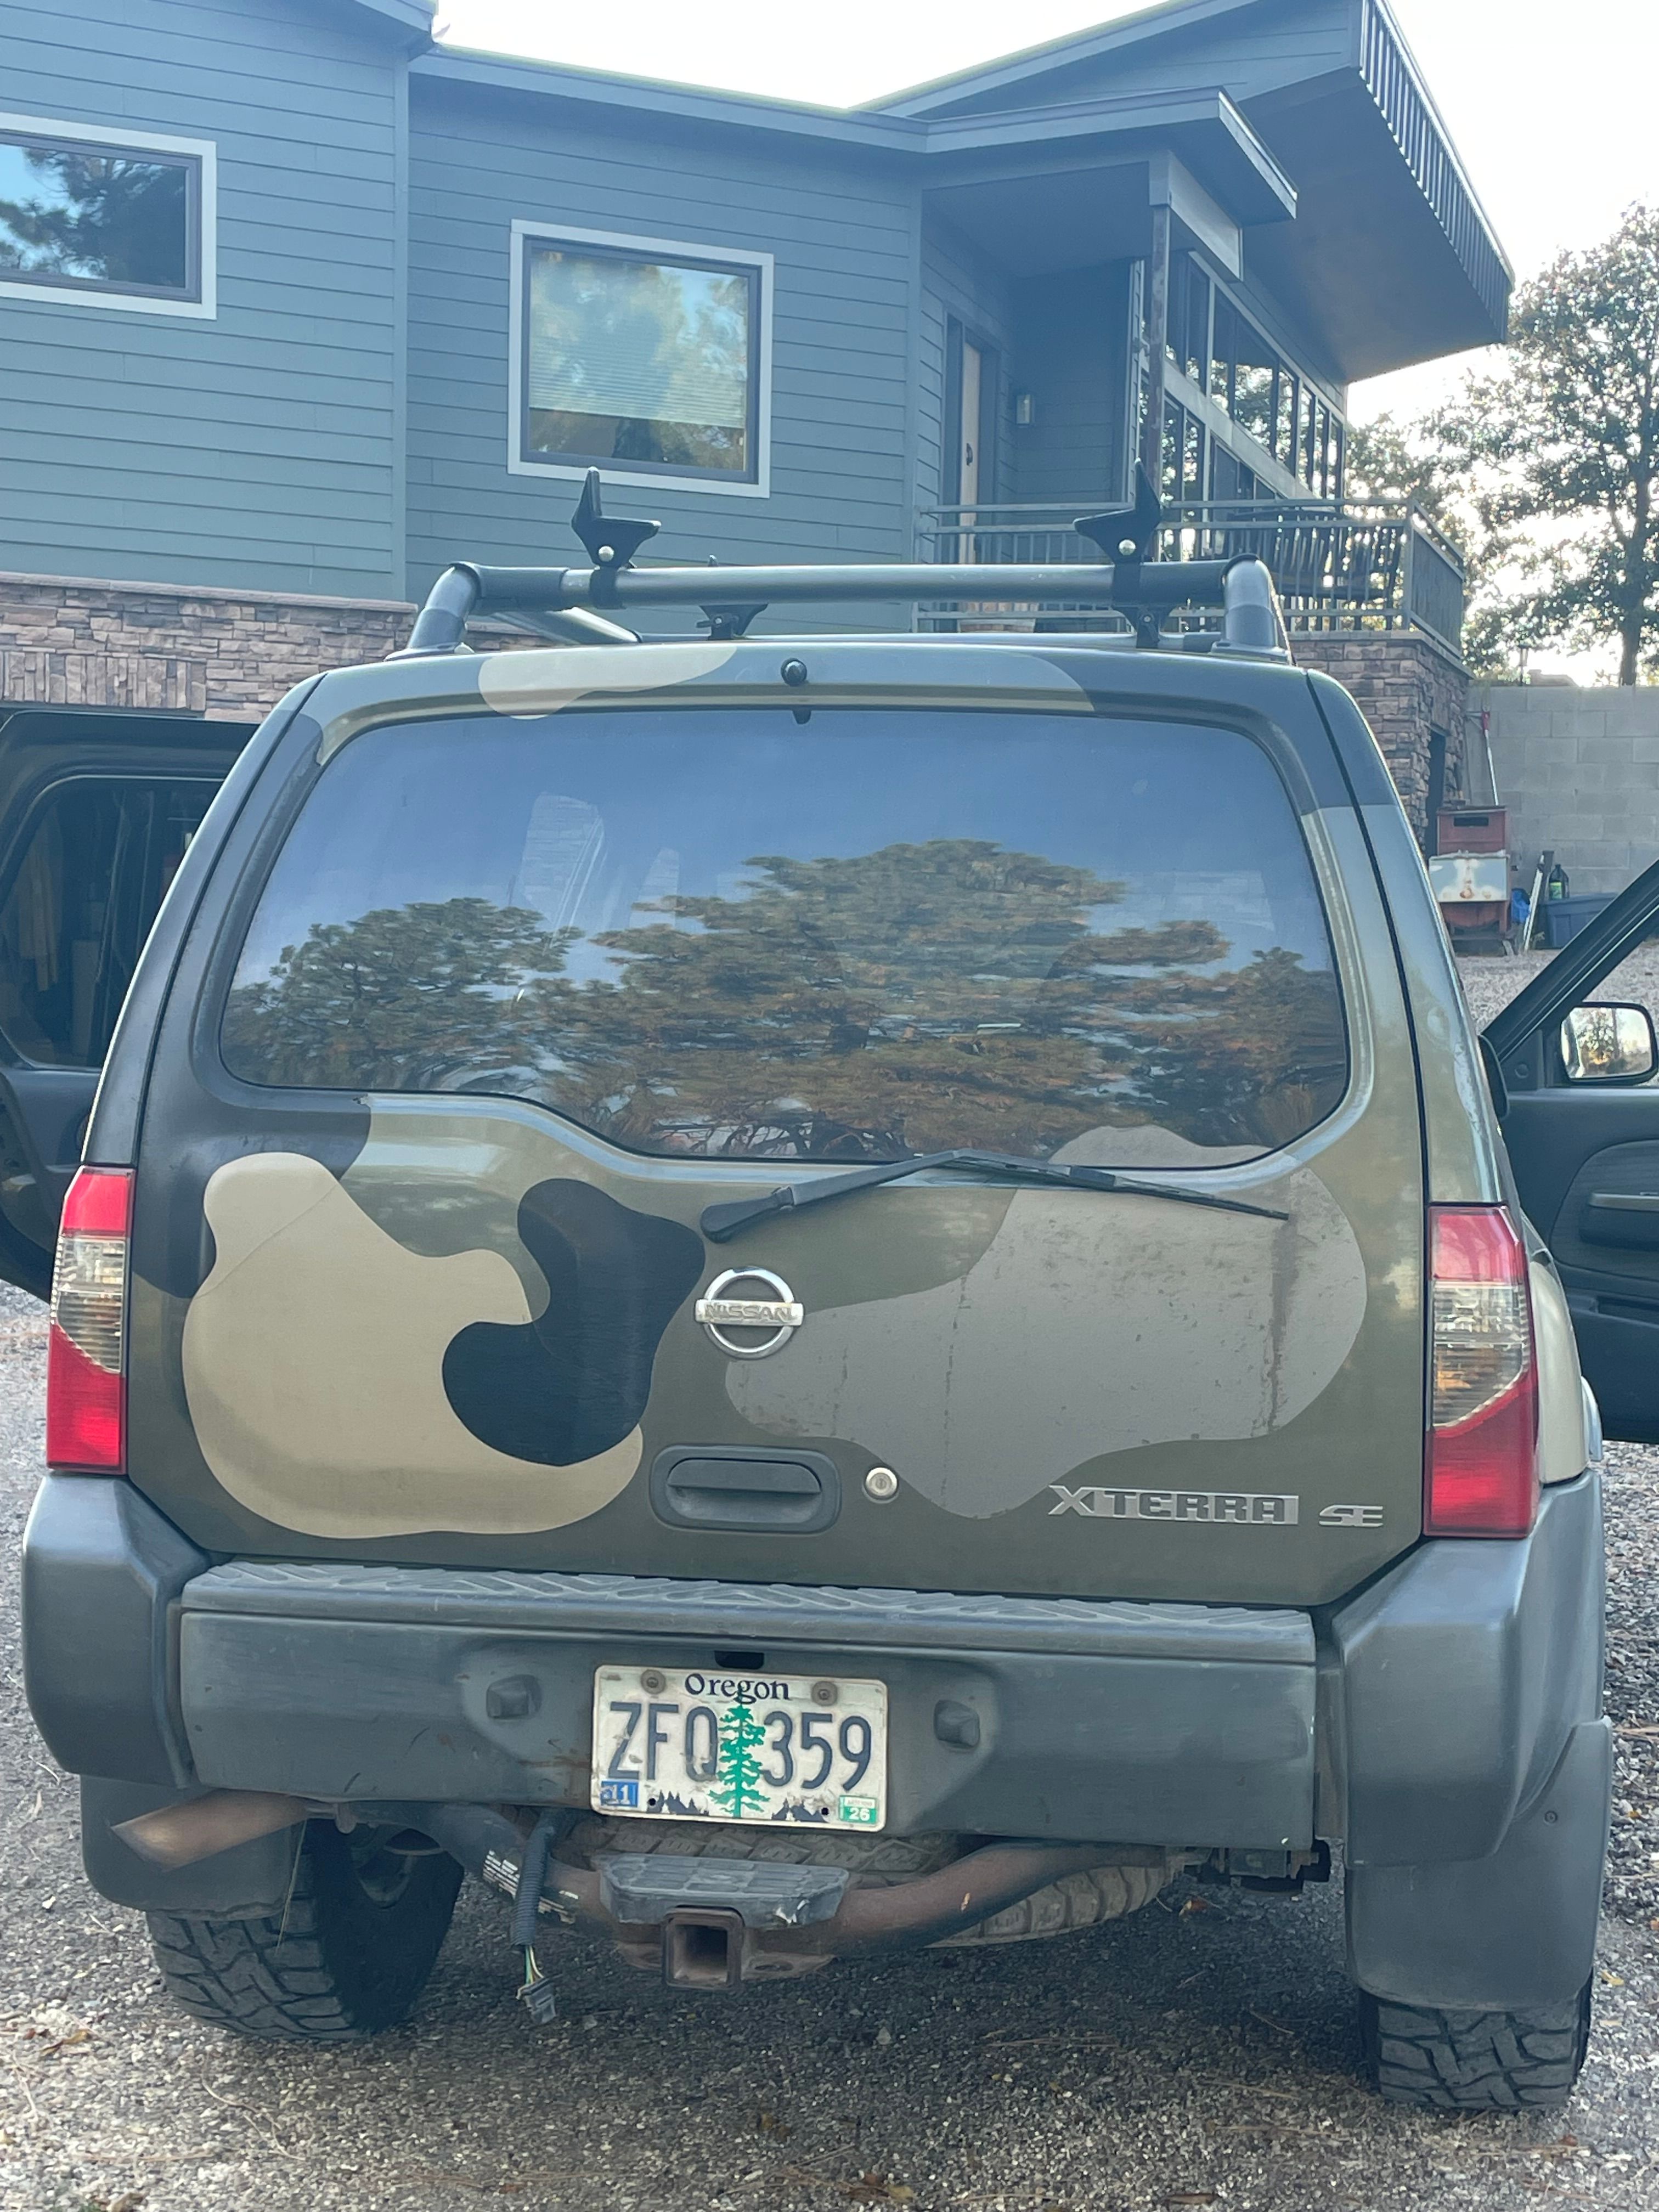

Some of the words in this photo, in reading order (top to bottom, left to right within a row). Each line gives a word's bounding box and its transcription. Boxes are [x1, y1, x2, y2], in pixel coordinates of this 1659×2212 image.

[704, 1303, 794, 1323] NISSAN
[1048, 1485, 1299, 1525] XTERRA
[1319, 1505, 1383, 1527] SE
[685, 1673, 791, 1704] Oregon
[763, 1711, 871, 1791] 359
[849, 1807, 870, 1821] 26
